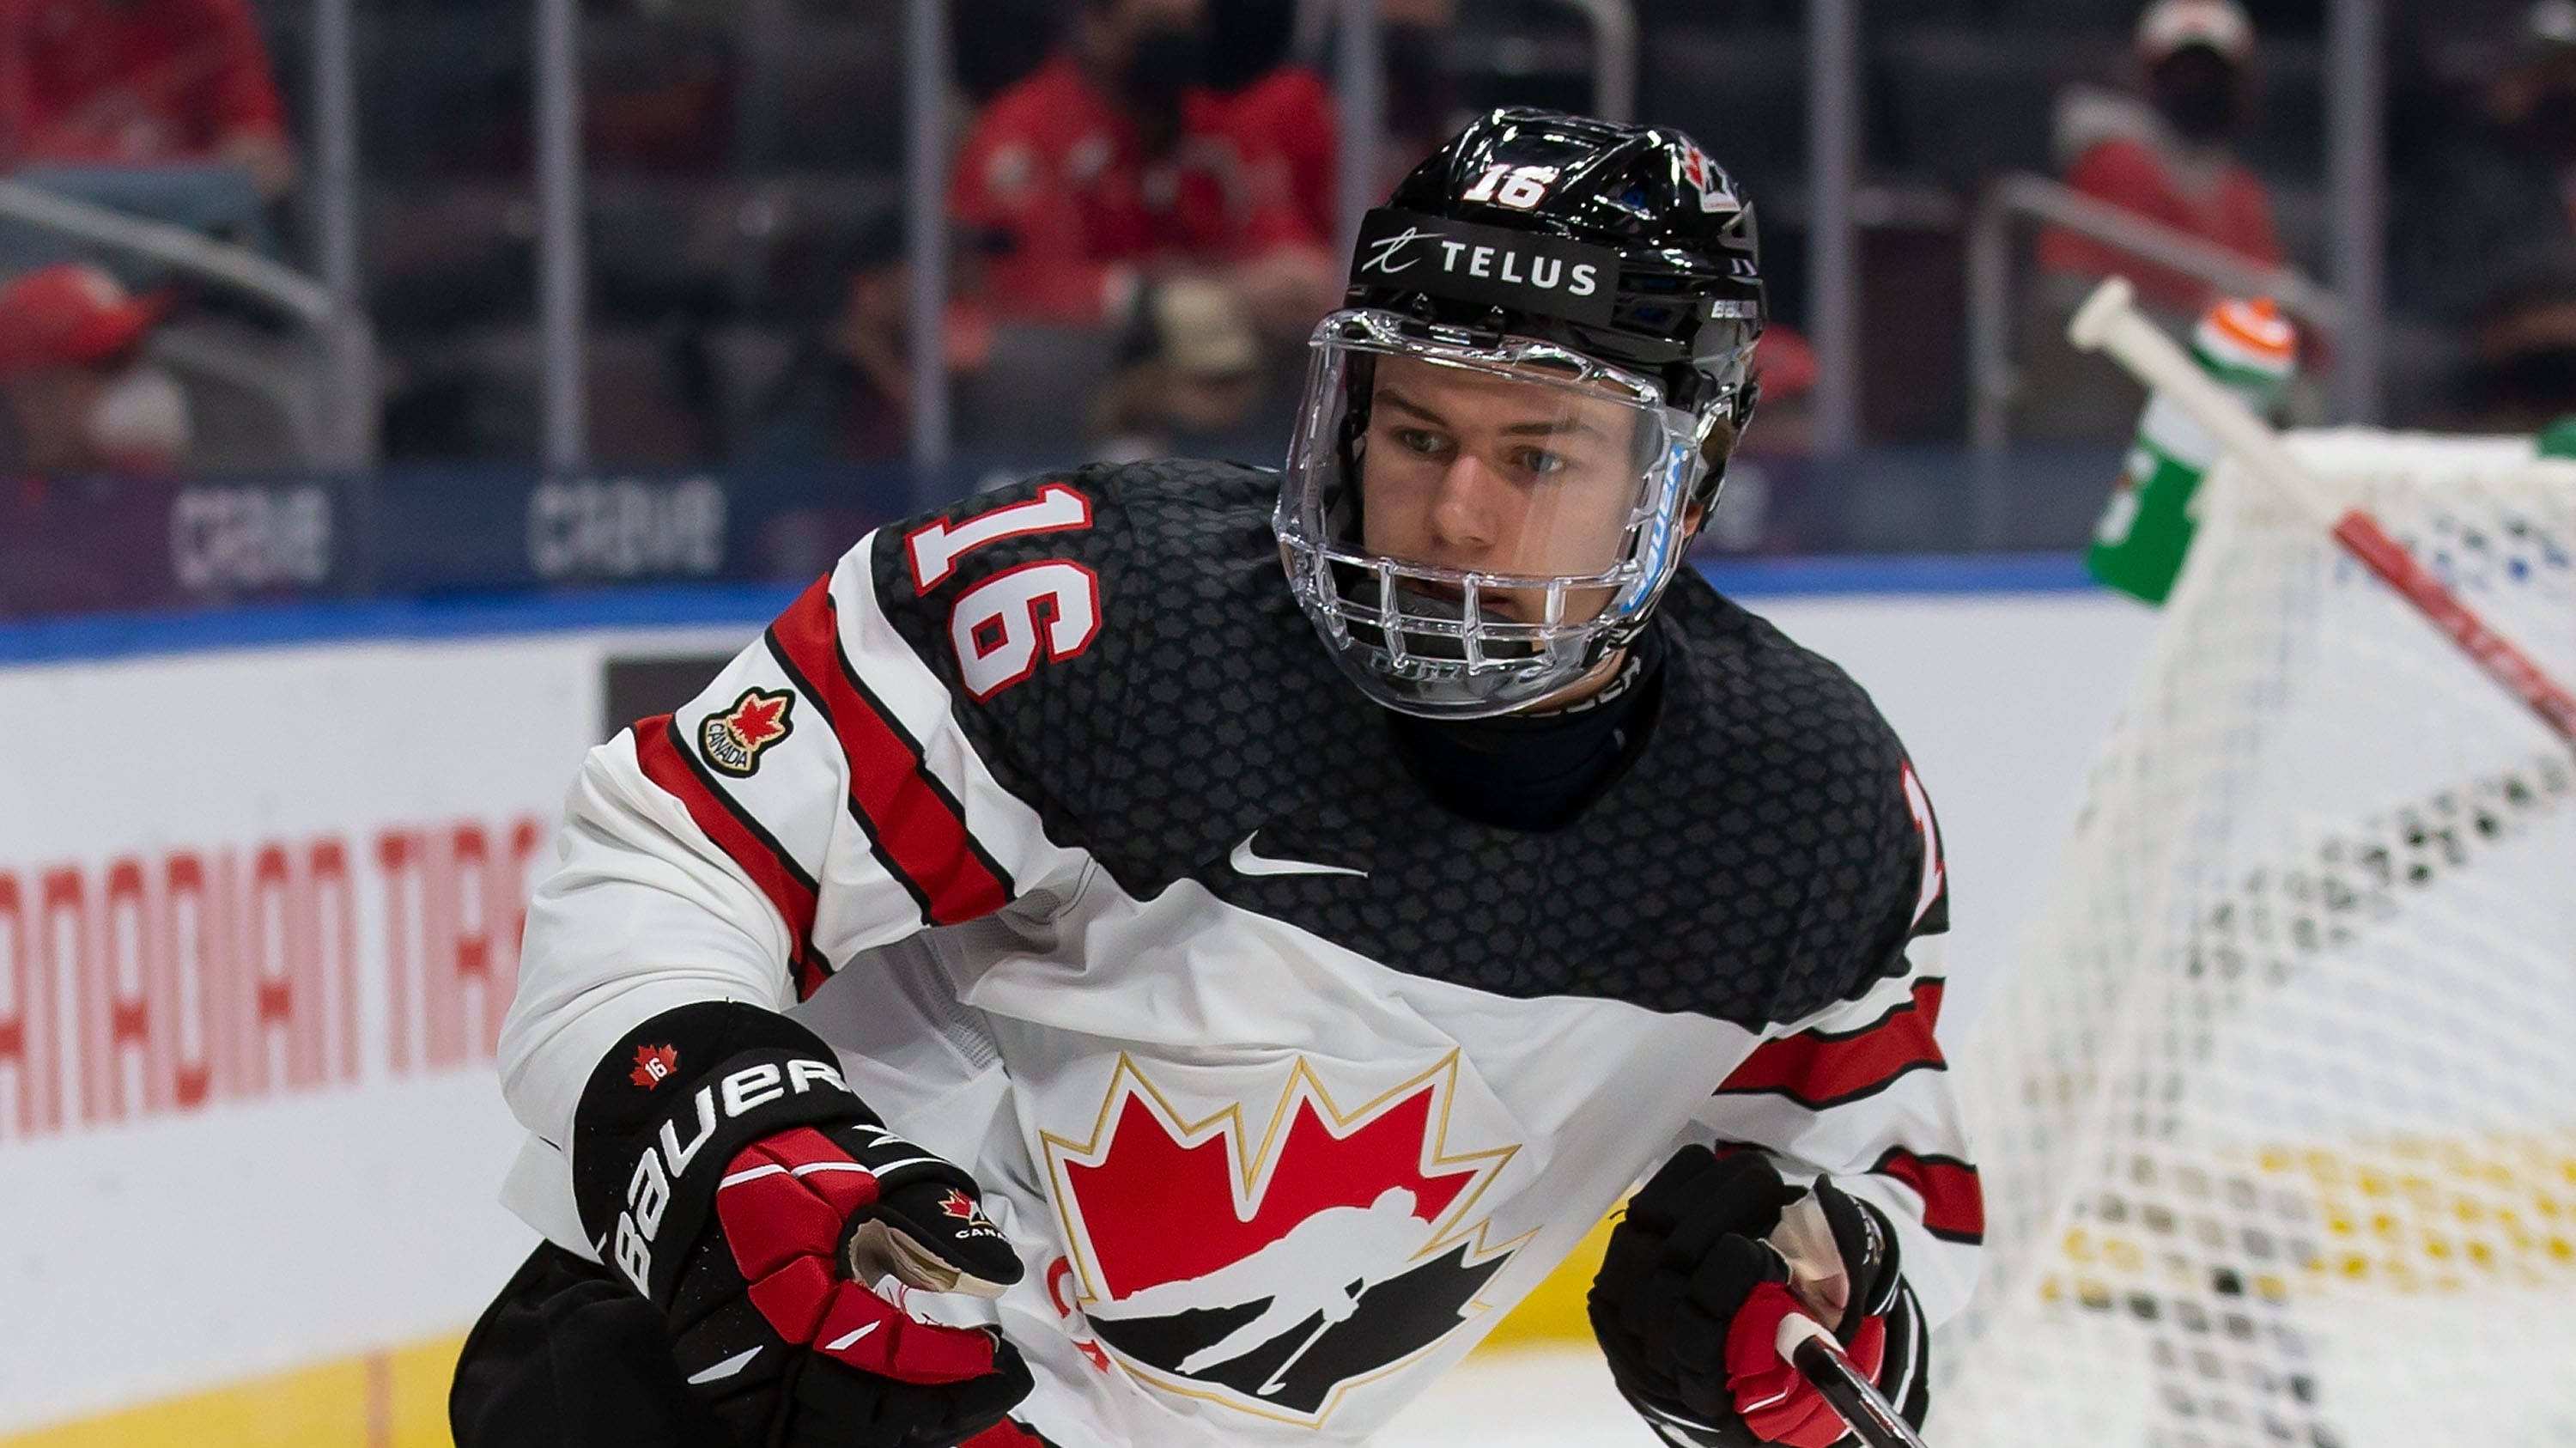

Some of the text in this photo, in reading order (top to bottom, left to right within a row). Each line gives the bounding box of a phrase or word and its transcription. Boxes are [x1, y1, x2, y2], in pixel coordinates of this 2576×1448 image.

[1461, 162, 1560, 211] 16
[1441, 240, 1598, 296] TELUS
[905, 483, 1102, 704] 16
[707, 722, 749, 768] CANADA
[644, 1057, 668, 1082] 16
